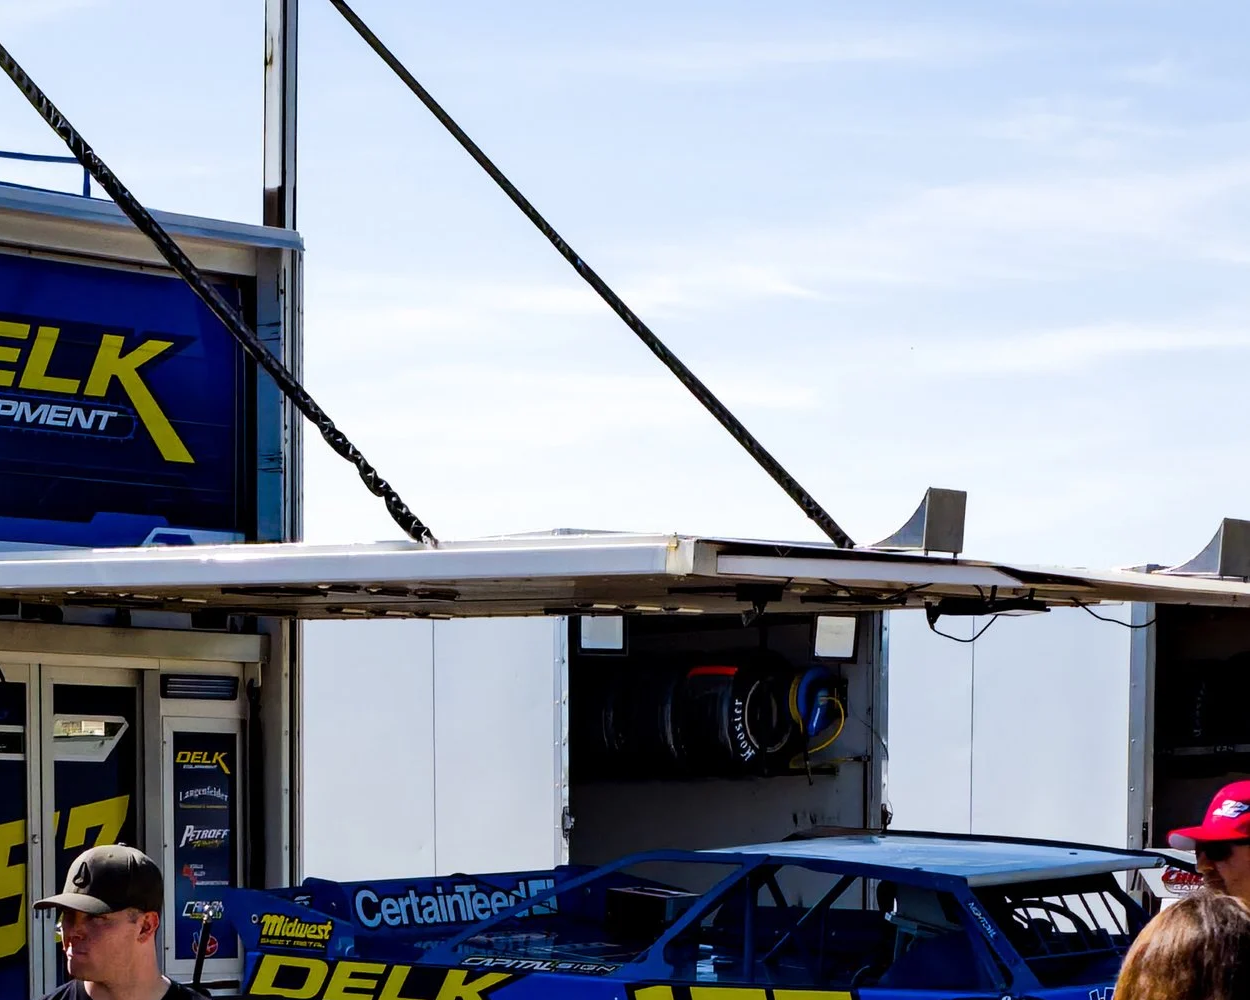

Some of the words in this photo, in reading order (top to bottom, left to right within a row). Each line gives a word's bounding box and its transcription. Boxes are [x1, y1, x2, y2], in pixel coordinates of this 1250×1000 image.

[175, 751, 231, 774] DELK
[179, 786, 229, 802] Langenfelder
[179, 825, 230, 848] PETROFF
[258, 913, 333, 940] Midwest
[461, 956, 553, 971] CAPITAL
